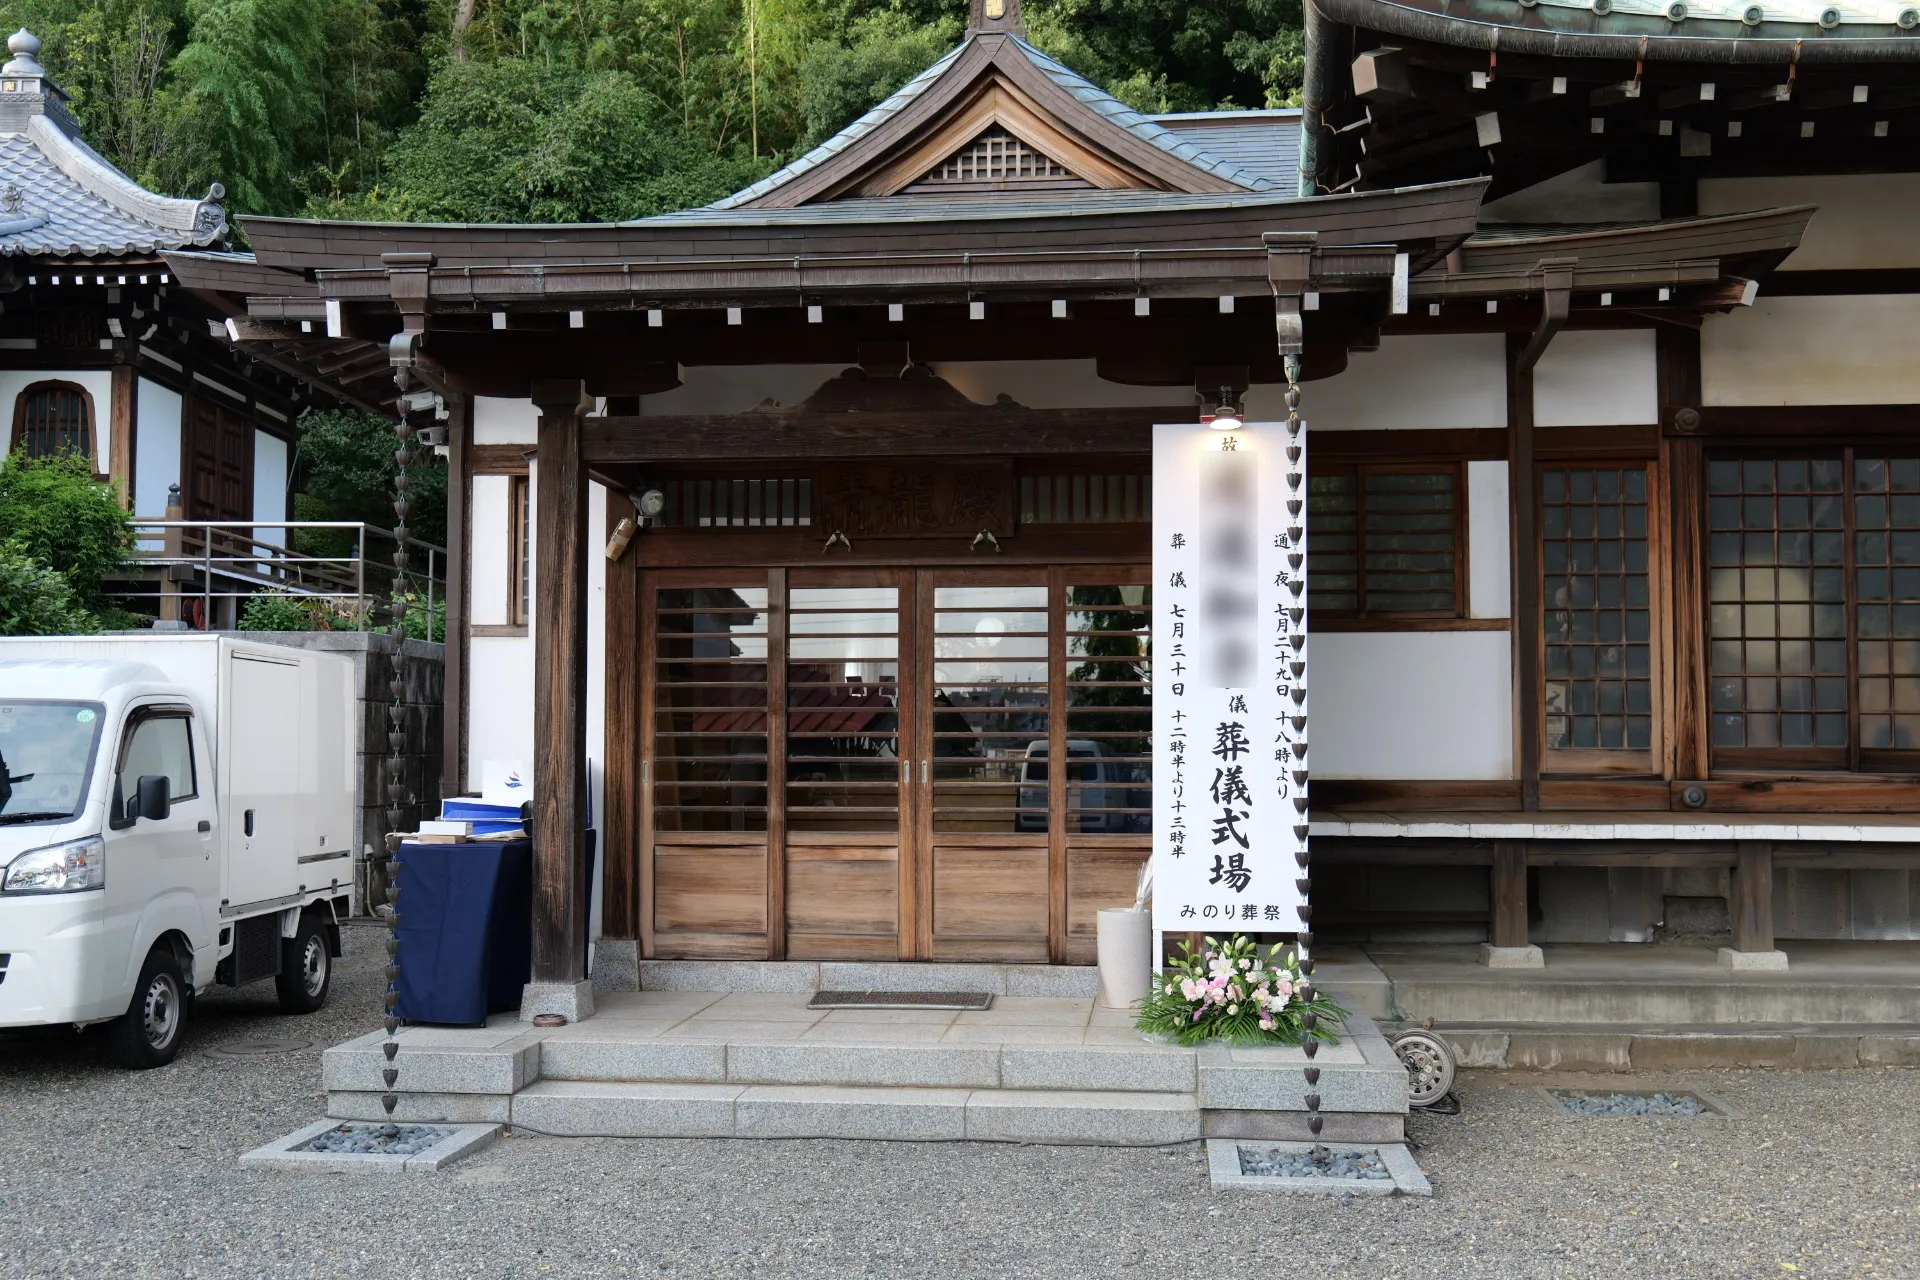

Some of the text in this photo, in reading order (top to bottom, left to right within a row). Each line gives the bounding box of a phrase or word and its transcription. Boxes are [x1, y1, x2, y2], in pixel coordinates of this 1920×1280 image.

[1169, 532, 1187, 860] 葬儀 七月三十日 十二時半より十三時半
[1228, 695, 1249, 714] 儀
[1273, 533, 1292, 800] 通夜 七月二十九日 十八時より
[1208, 721, 1253, 893] 葬儀式場
[1180, 904, 1280, 921] みのり葬祭
